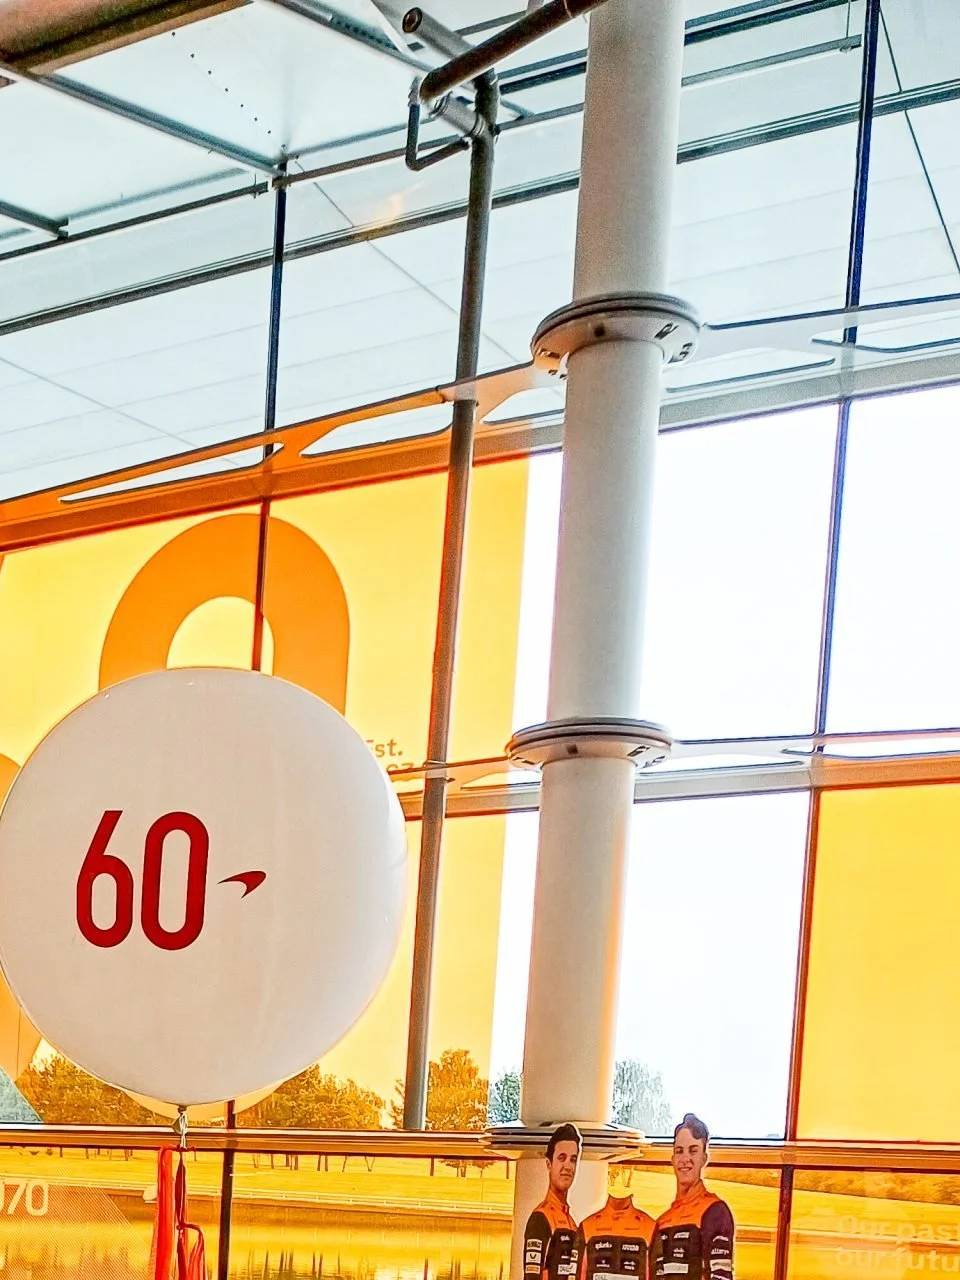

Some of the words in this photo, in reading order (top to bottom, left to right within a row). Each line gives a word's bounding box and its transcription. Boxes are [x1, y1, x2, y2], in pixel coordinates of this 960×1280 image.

[366, 739, 403, 758] st.
[76, 810, 209, 951] 60
[835, 1249, 887, 1267] our
